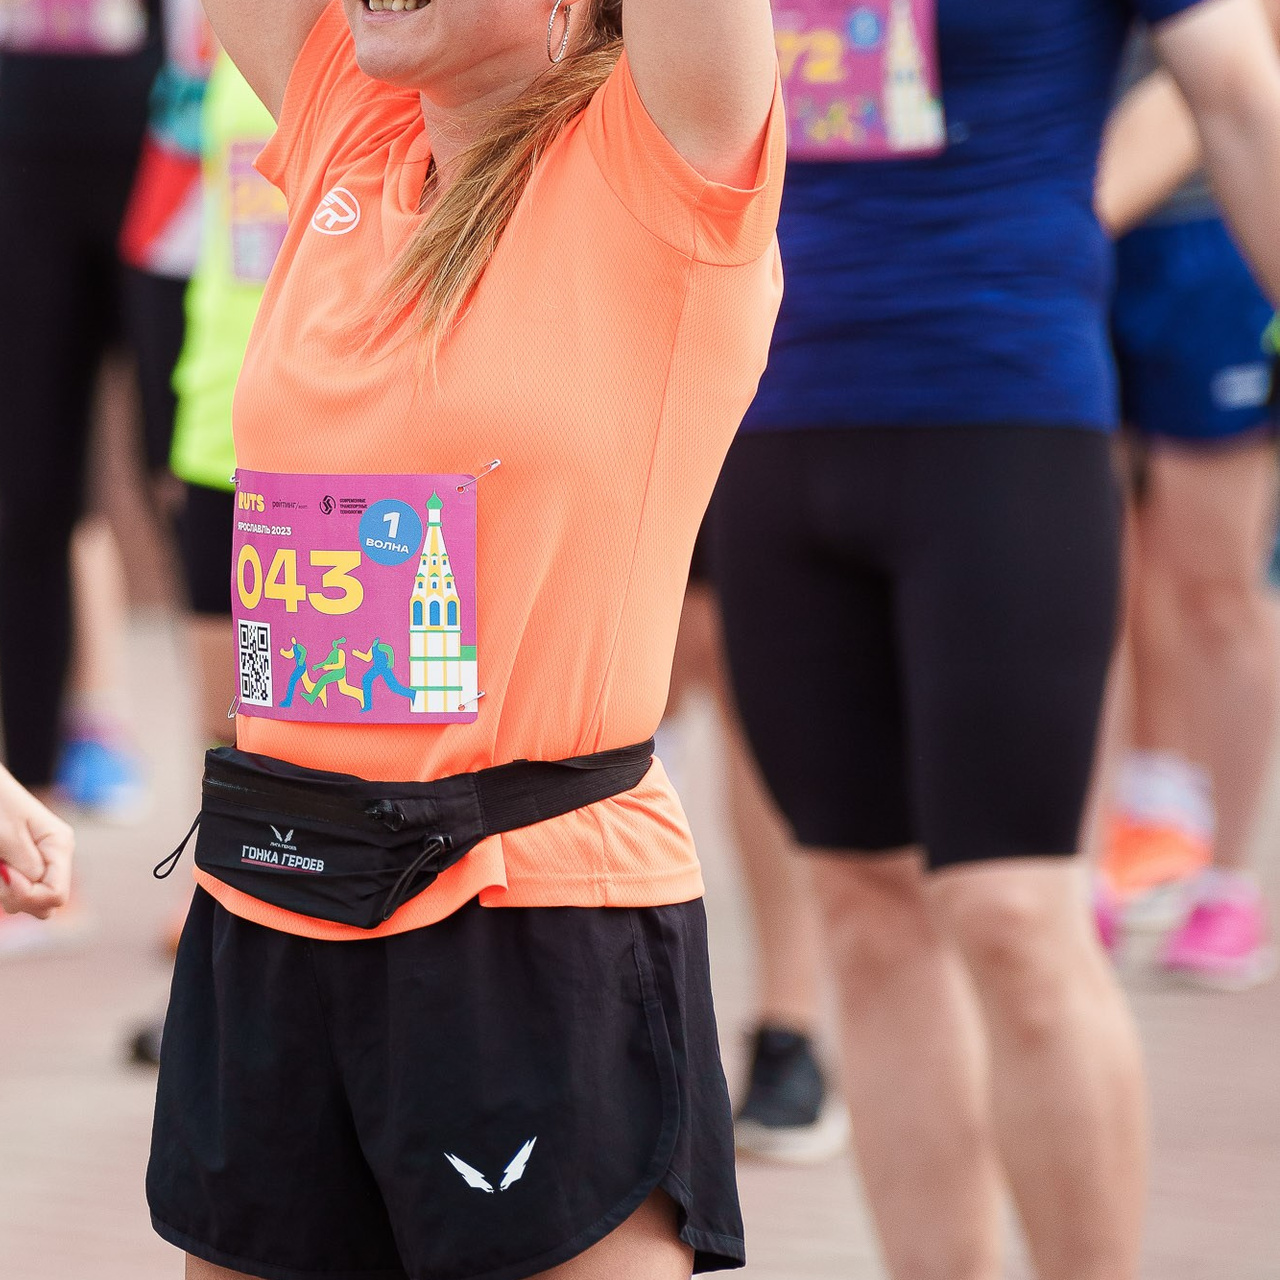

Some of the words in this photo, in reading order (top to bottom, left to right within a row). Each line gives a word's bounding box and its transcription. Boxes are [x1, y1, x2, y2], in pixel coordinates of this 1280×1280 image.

[772, 28, 848, 85] 72
[238, 491, 265, 512] RUTS
[237, 521, 271, 535] ЯРОСЛАВЛЬ
[271, 525, 292, 536] 2023
[382, 511, 401, 538] 1
[366, 537, 409, 554] ВОЛНА
[237, 544, 364, 615] 043
[241, 845, 278, 865] ГОНКА
[280, 853, 324, 872] ГЕРОЕВ
